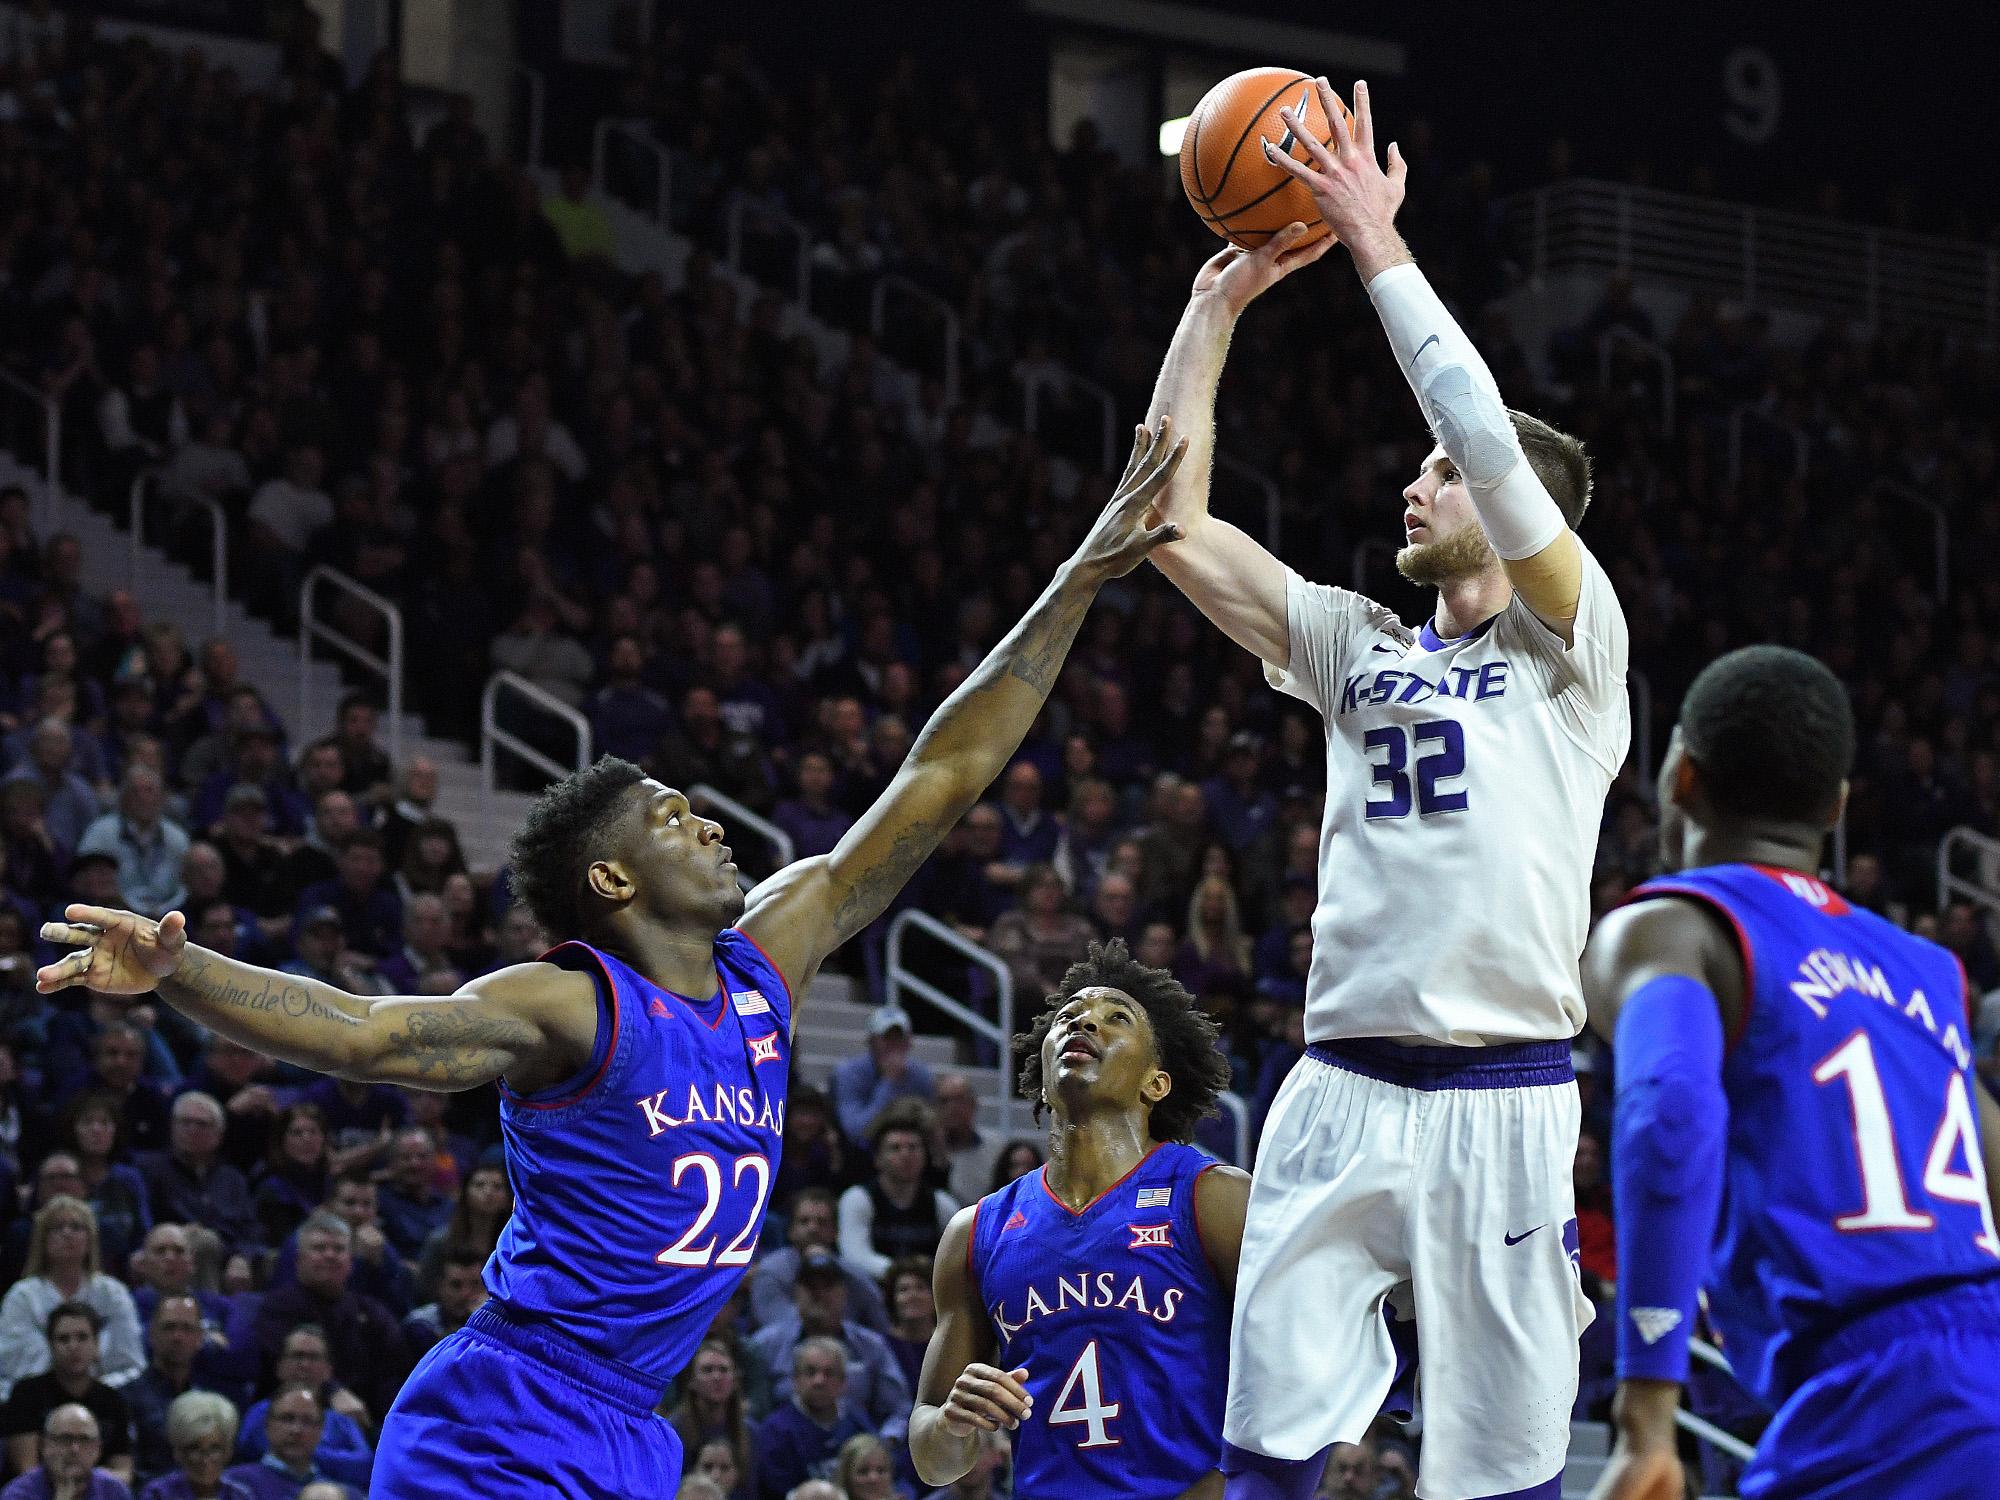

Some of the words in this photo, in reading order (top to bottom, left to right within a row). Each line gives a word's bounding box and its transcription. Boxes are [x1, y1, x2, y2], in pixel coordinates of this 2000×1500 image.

[1723, 47, 1780, 144] 9
[1363, 719, 1469, 821] 32
[636, 1082, 784, 1138] KANSAS
[1811, 1028, 2000, 1260] 14
[654, 1150, 771, 1268] 22
[1130, 1224, 1171, 1247] XII
[993, 1272, 1185, 1345] KANSAS
[1048, 1338, 1122, 1450] 4
